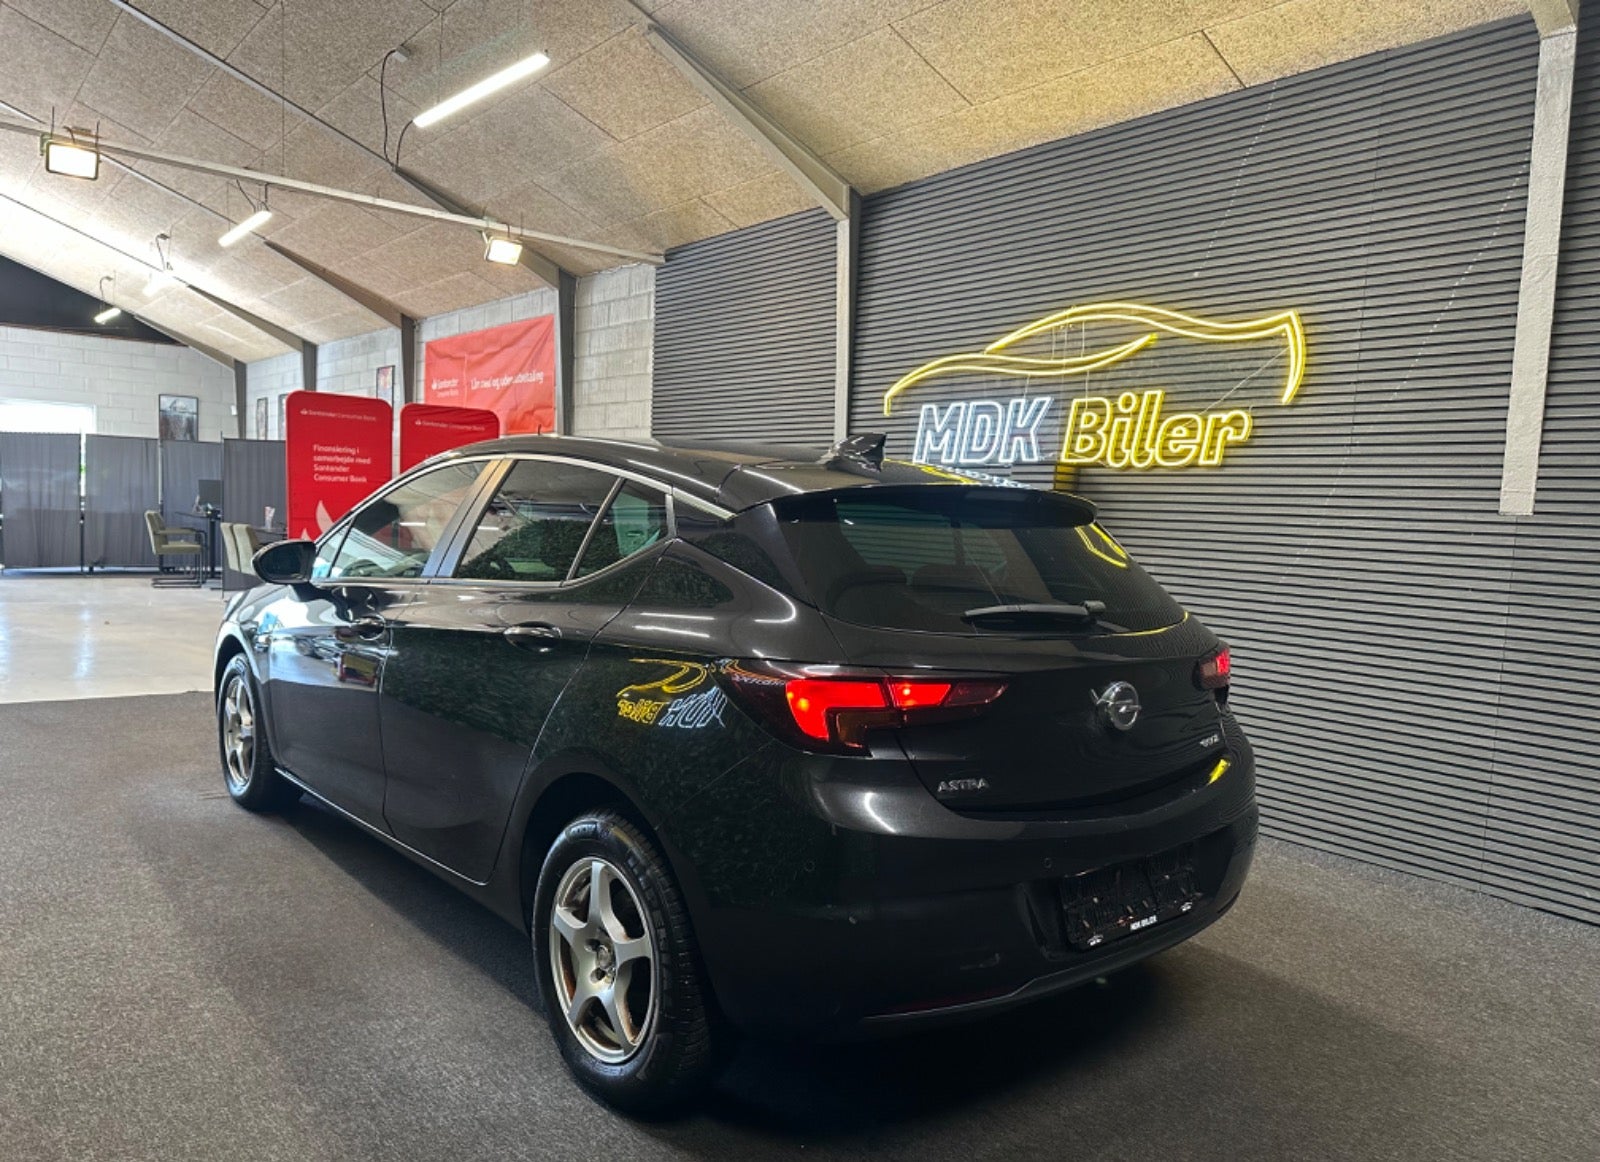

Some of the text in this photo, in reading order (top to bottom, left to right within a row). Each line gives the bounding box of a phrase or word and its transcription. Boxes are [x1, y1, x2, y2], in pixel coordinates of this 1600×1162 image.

[912, 389, 1253, 469] MDK Biler
[313, 444, 356, 455] Finansiering
[313, 455, 371, 465] samarbejde med
[313, 464, 350, 472] Santander
[313, 473, 367, 483] Consumer Bank
[938, 778, 990, 792] ASTRA
